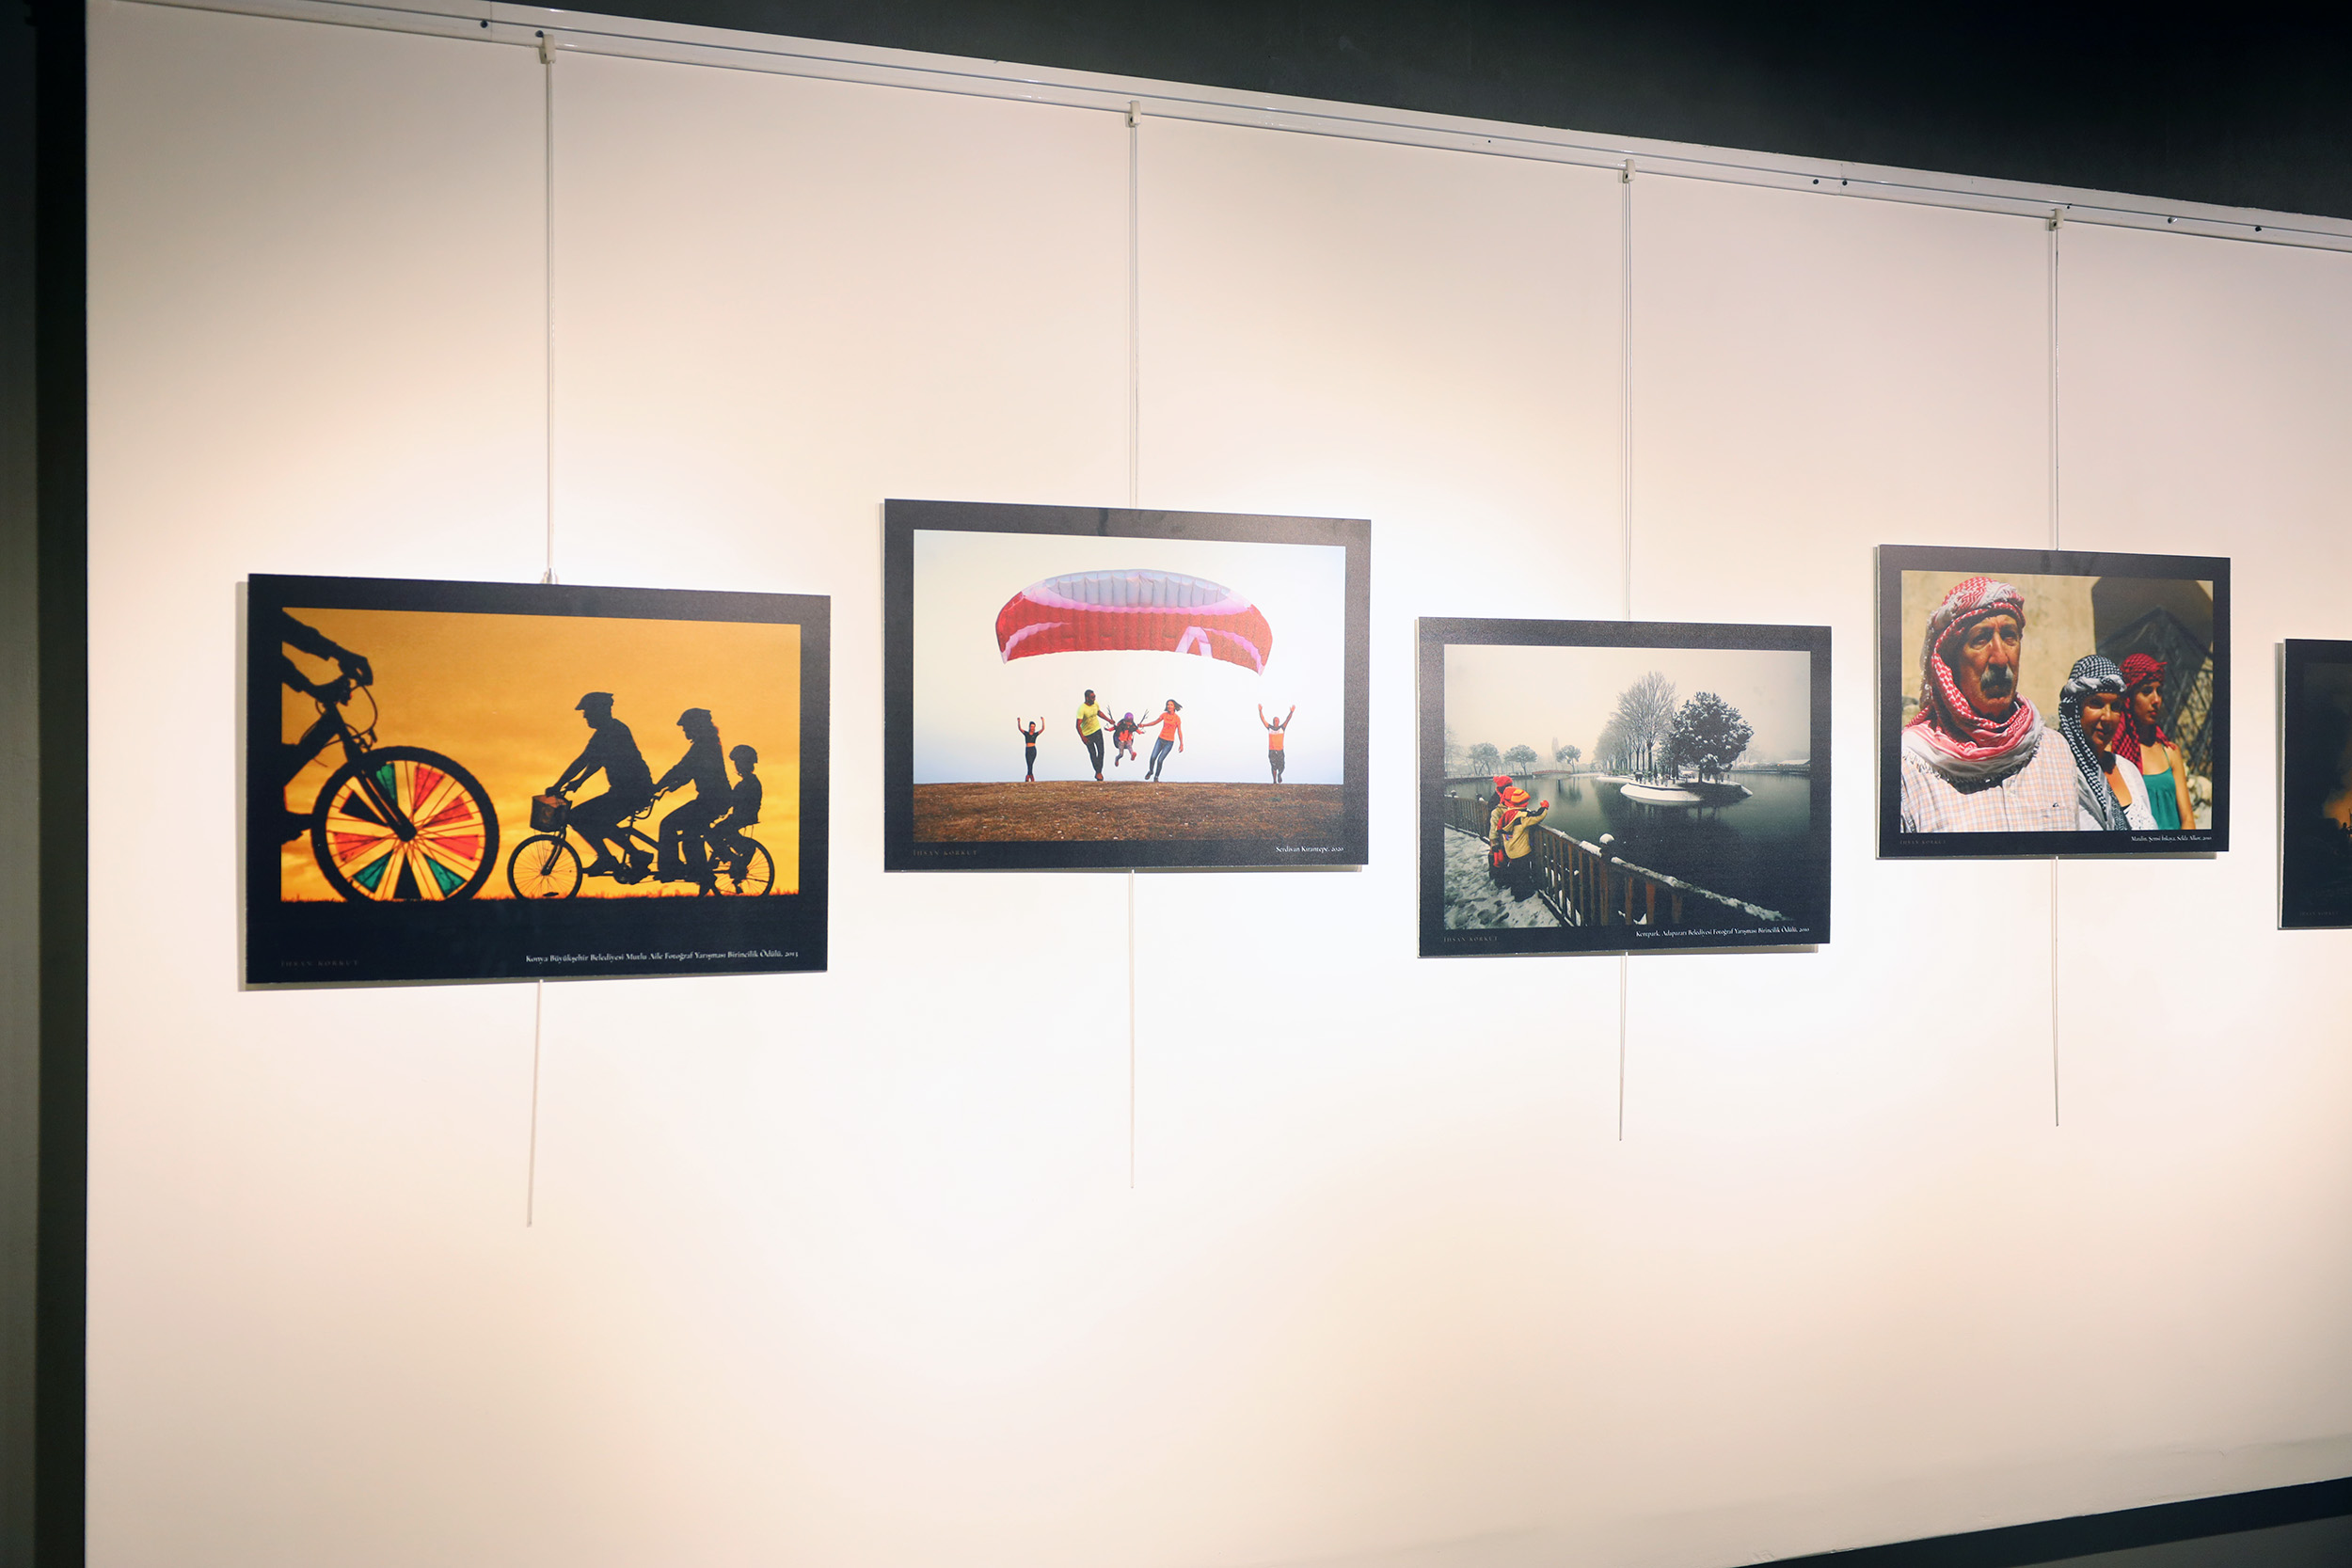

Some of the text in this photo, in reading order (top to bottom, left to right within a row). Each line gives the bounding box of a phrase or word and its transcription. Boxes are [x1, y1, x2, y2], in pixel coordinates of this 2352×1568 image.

[1713, 928, 1733, 936] Fotoğraf
[525, 954, 548, 964] Konya
[549, 953, 589, 964] Büyükşehir
[590, 952, 625, 963] Belediyesi
[626, 952, 647, 960] Mutlu
[648, 951, 663, 960] Aile
[664, 950, 693, 961] Fotoğraf
[694, 950, 726, 960] Yarışması
[727, 950, 759, 959] Birincilik
